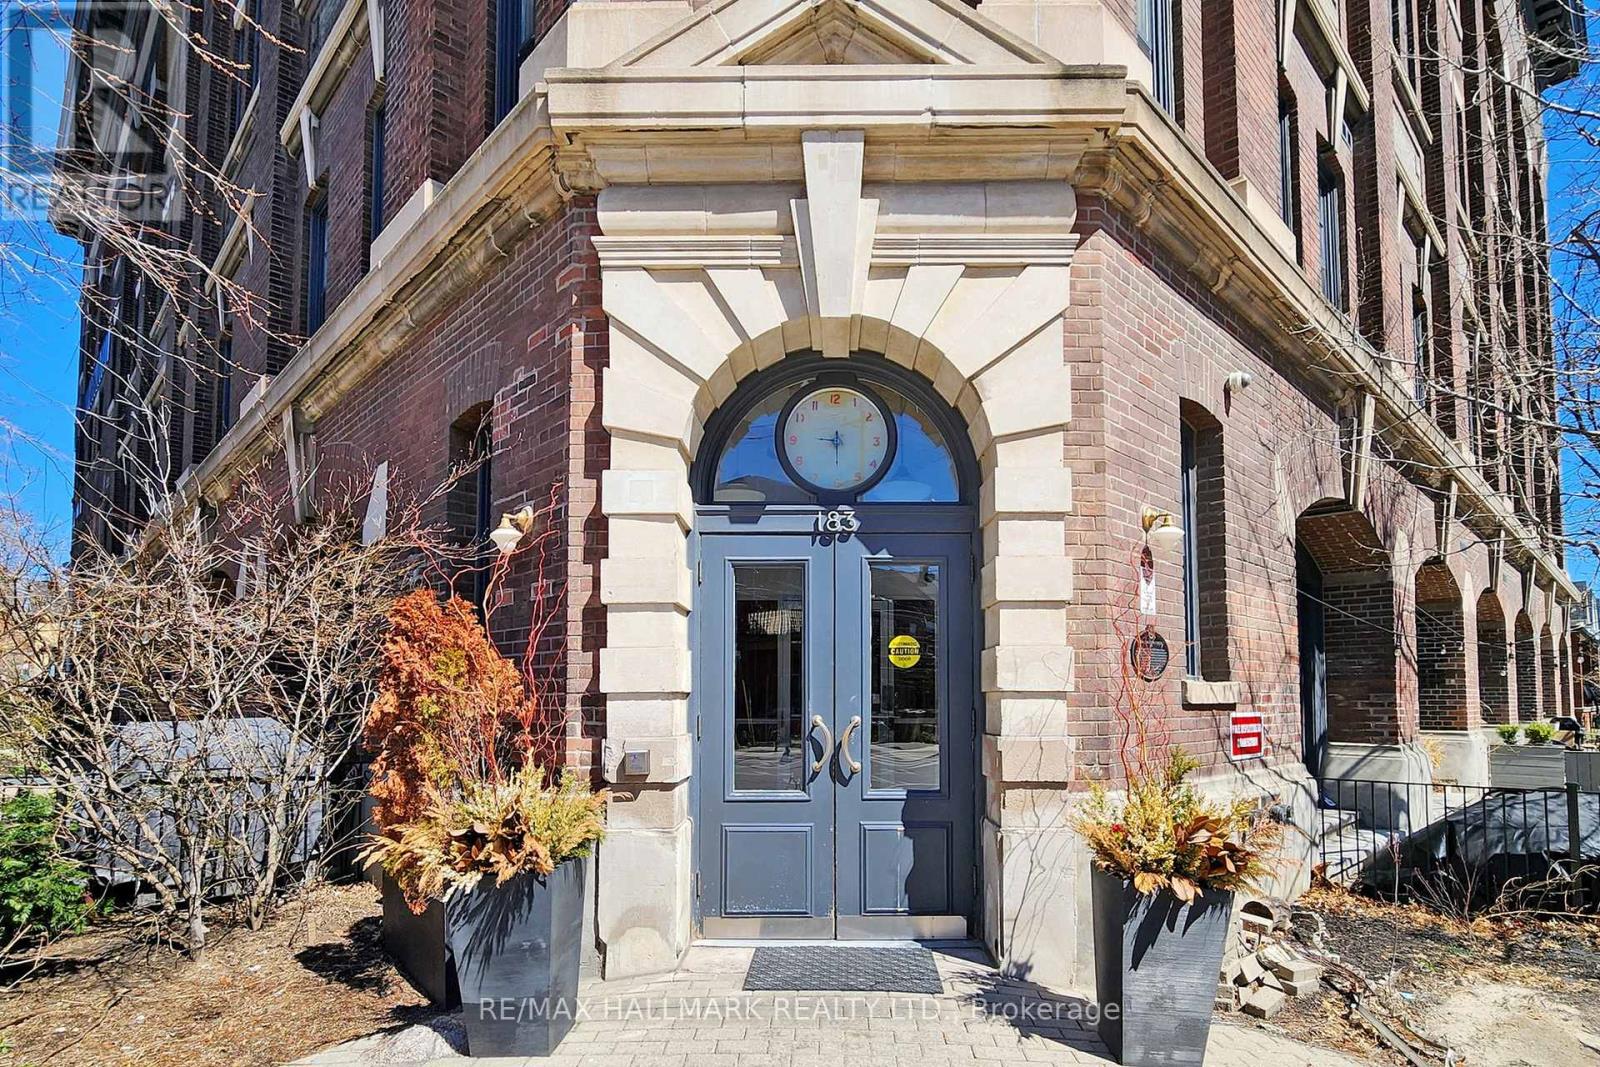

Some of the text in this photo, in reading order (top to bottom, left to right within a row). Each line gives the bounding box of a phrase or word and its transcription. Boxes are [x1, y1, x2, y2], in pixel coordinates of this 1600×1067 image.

[830, 394, 840, 404] 12
[812, 401, 818, 411] 11
[865, 412, 873, 422] 2
[789, 435, 798, 445] 9
[873, 436, 880, 446] 3
[869, 459, 877, 469] 4
[817, 510, 856, 531] 183
